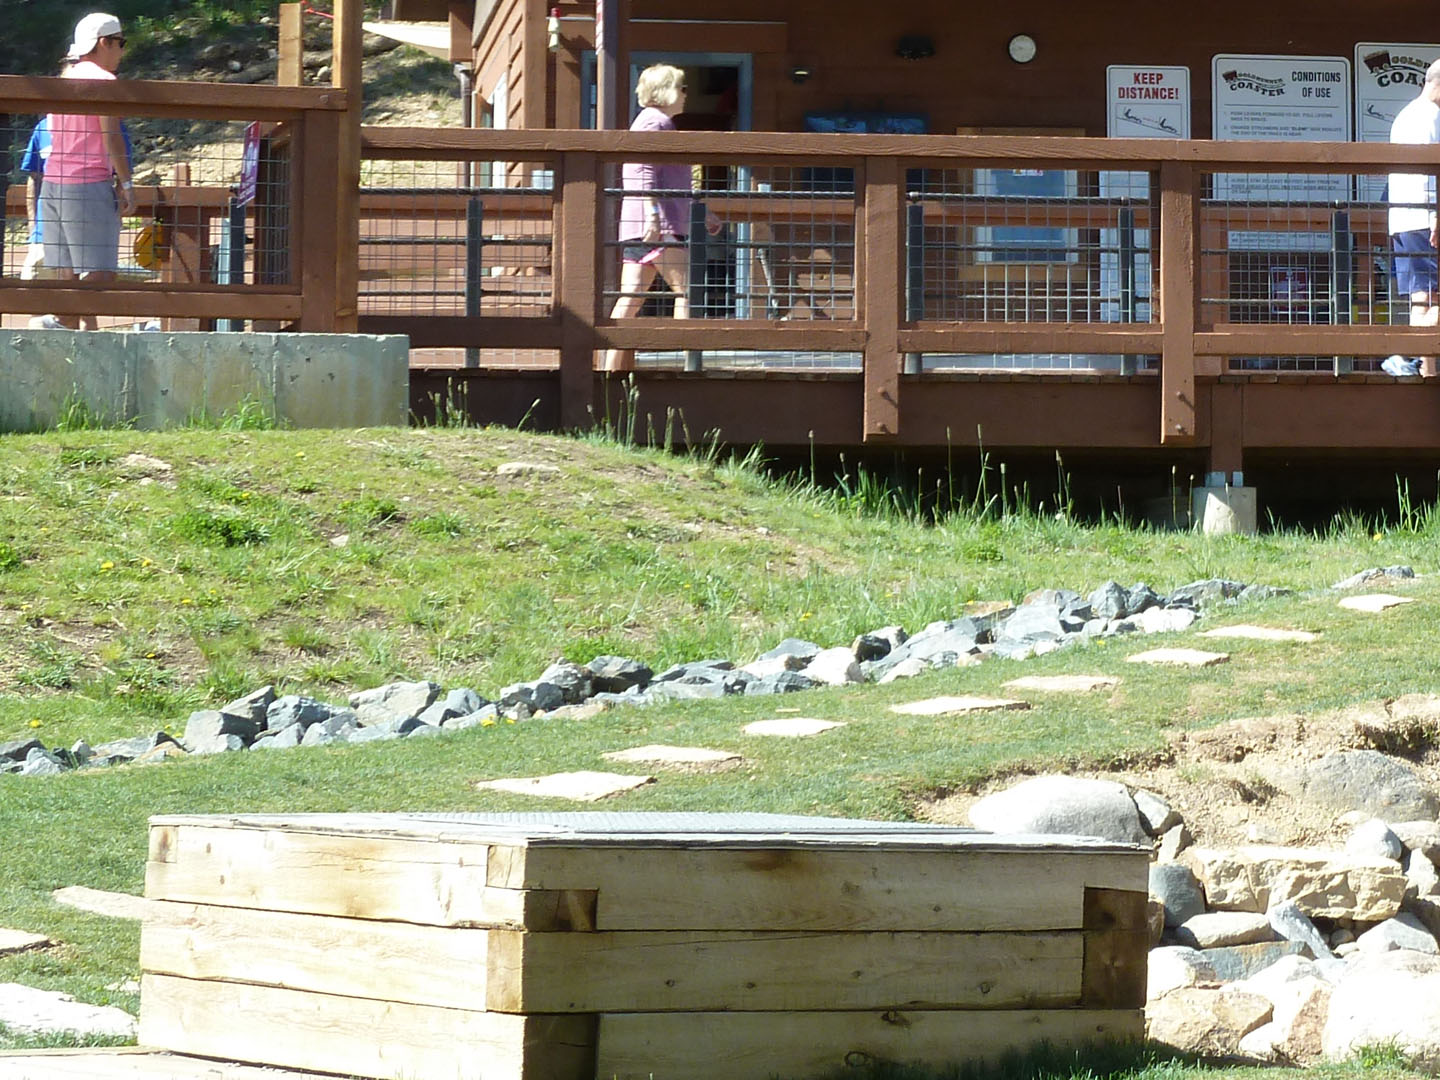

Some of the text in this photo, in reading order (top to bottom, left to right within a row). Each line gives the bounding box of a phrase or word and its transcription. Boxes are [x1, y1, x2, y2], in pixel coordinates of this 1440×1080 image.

[1133, 72, 1163, 85] KEEP
[1291, 71, 1342, 83] CONDITIONS
[1118, 87, 1179, 100] DISTANCE!
[1229, 81, 1285, 97] COASTER
[1302, 87, 1331, 98] OF USE
